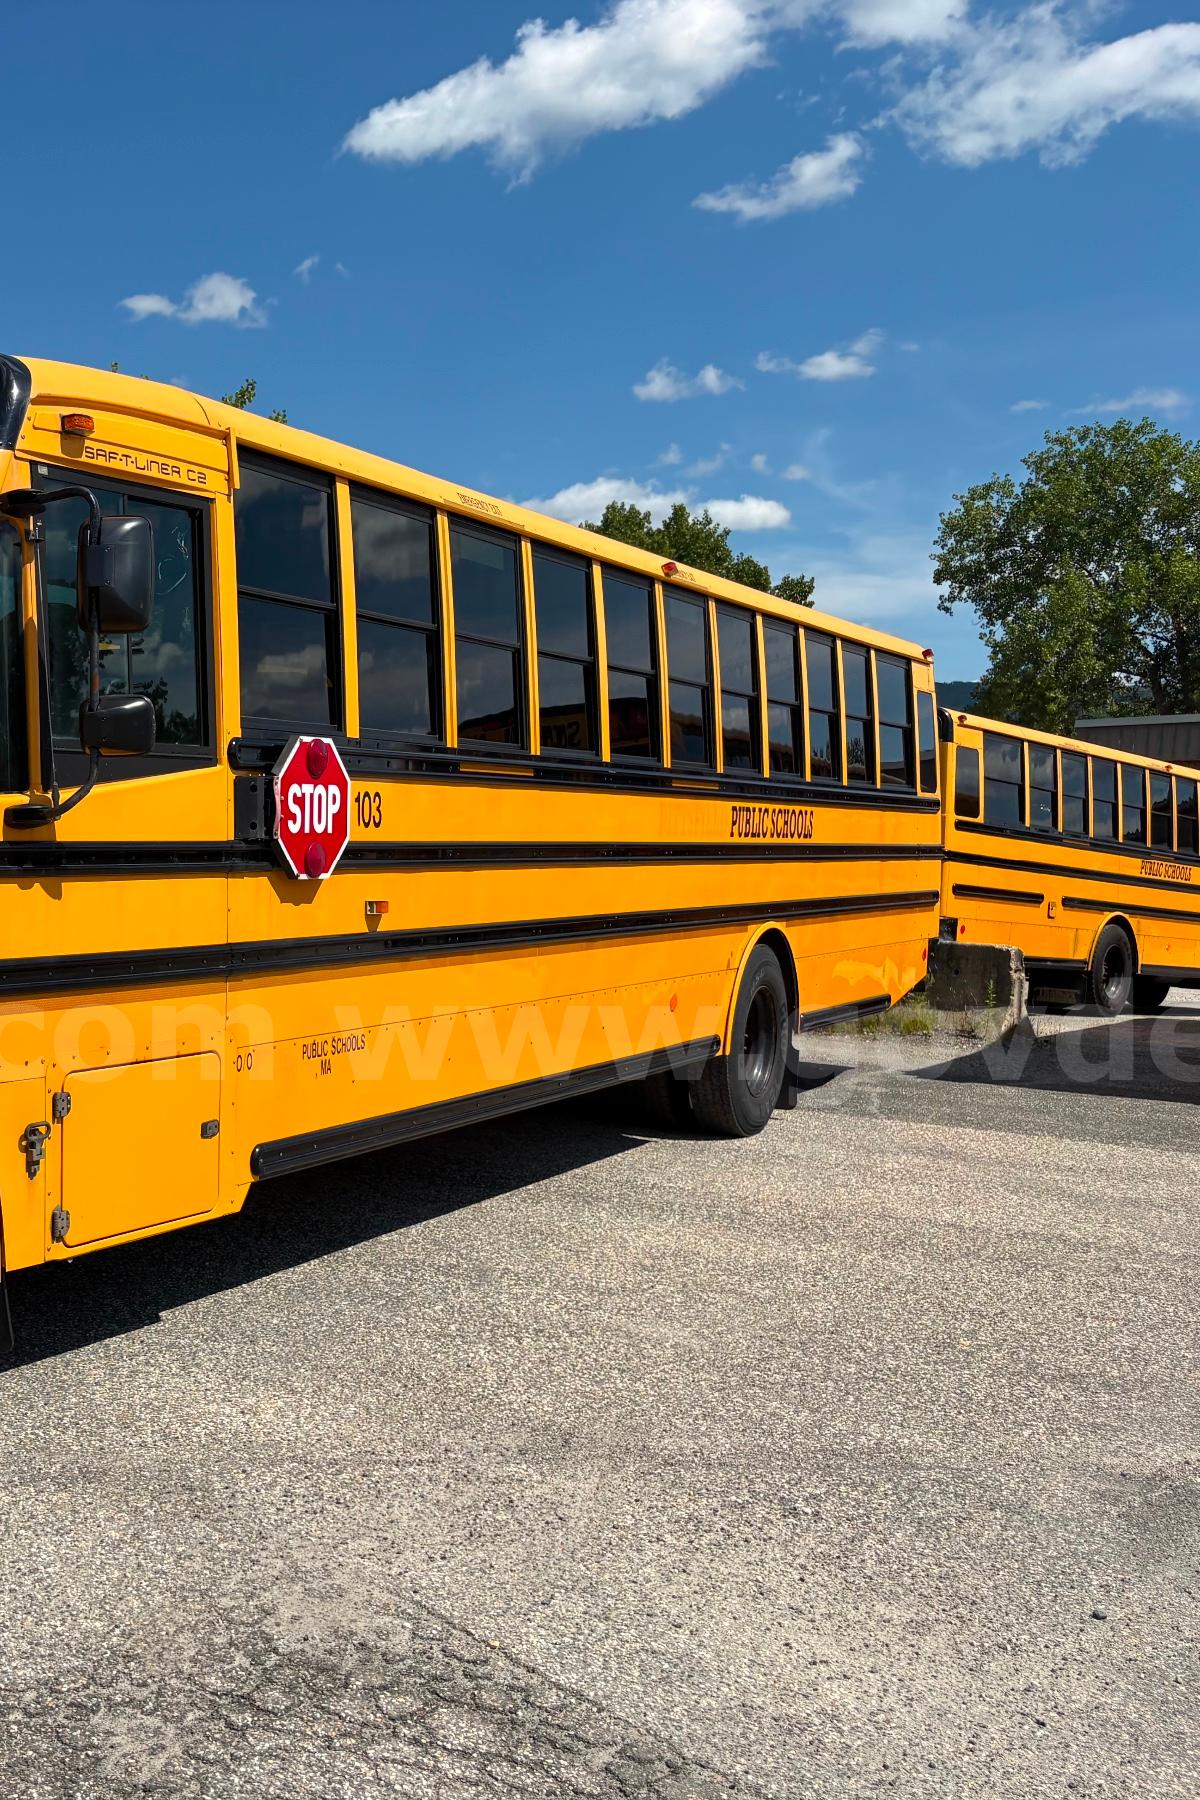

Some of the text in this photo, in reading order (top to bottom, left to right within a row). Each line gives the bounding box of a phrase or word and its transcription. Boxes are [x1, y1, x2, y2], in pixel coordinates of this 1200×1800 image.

[186, 469, 207, 485] C2
[287, 783, 341, 834] STOP
[355, 791, 382, 828] 103
[730, 805, 814, 839] PUBLIC SCHOOLS
[1140, 860, 1192, 881] PUBLIC SCHOOLS
[302, 1034, 366, 1060] PUBLIC SCHOOLS
[320, 1059, 332, 1075] MA
